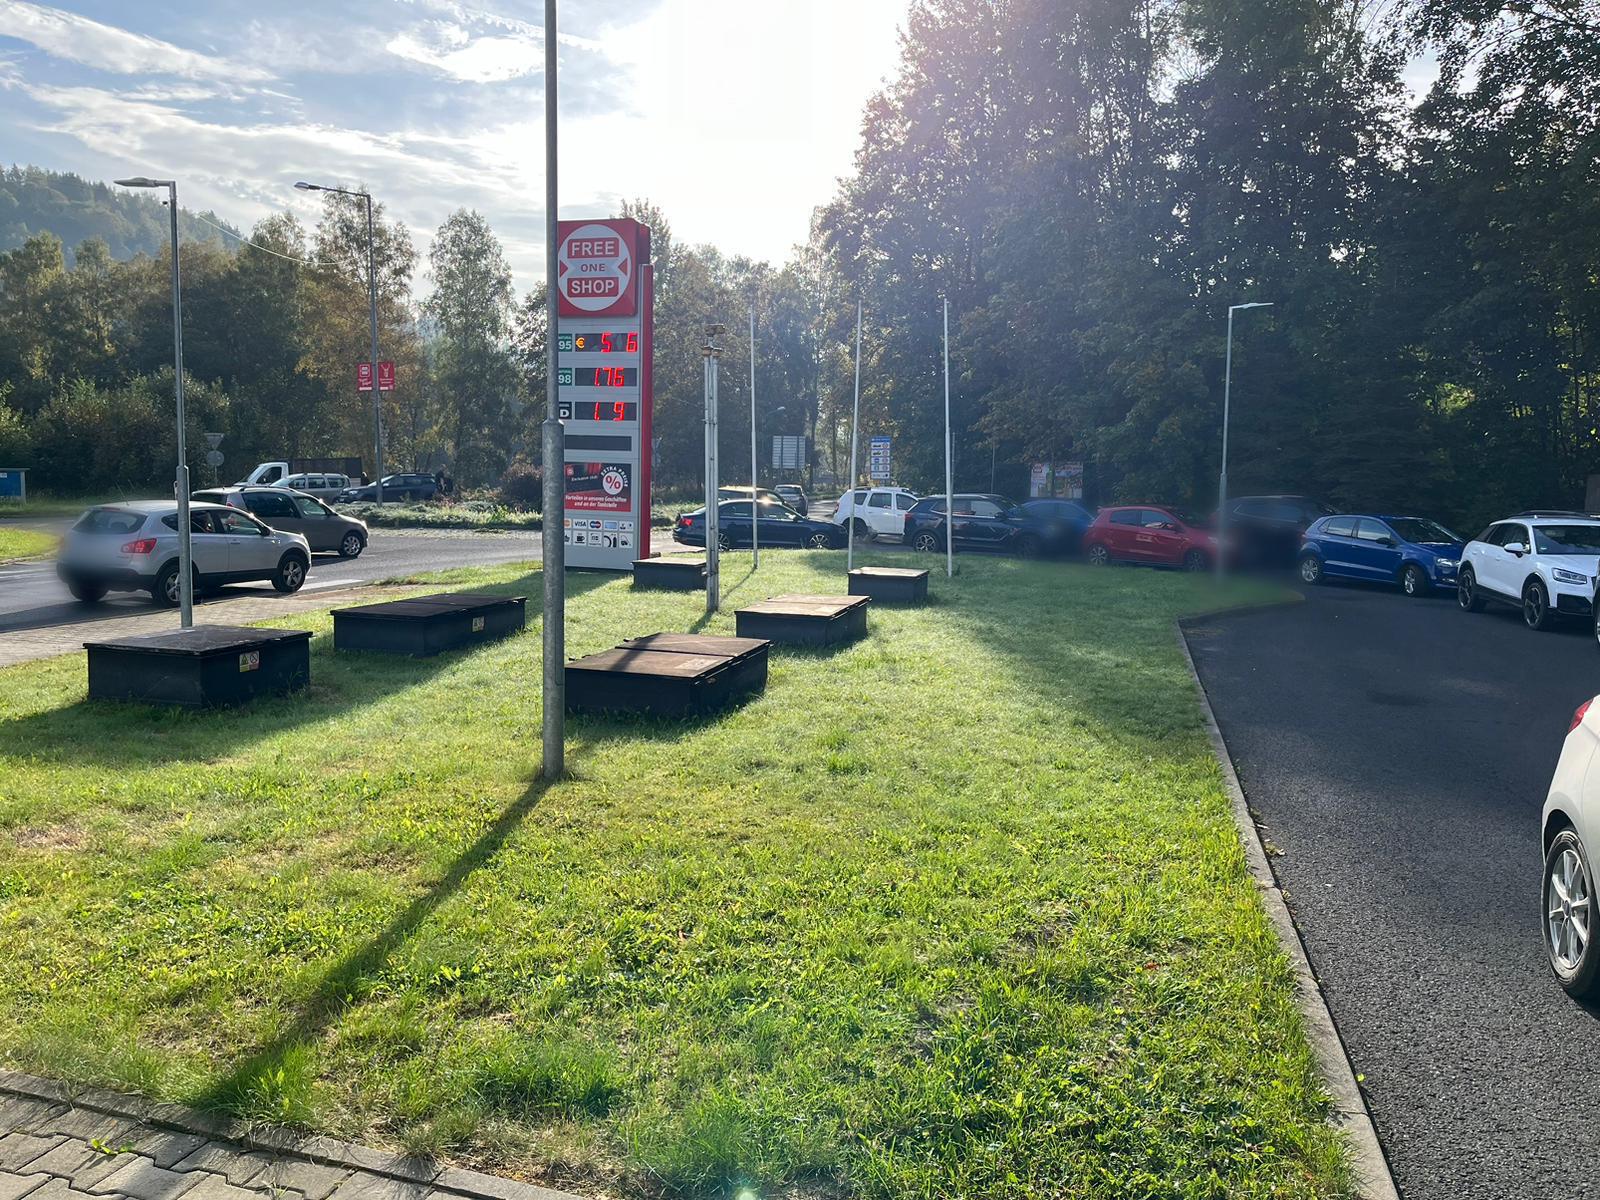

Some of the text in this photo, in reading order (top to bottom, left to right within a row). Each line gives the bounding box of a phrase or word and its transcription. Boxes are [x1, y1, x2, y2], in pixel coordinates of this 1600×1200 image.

[571, 241, 615, 256] FREE
[580, 263, 606, 272] ONE
[571, 279, 615, 294] SHOP
[558, 340, 572, 350] 95
[558, 374, 572, 384] 98
[559, 409, 570, 418] D
[600, 466, 618, 476] EXTRA
